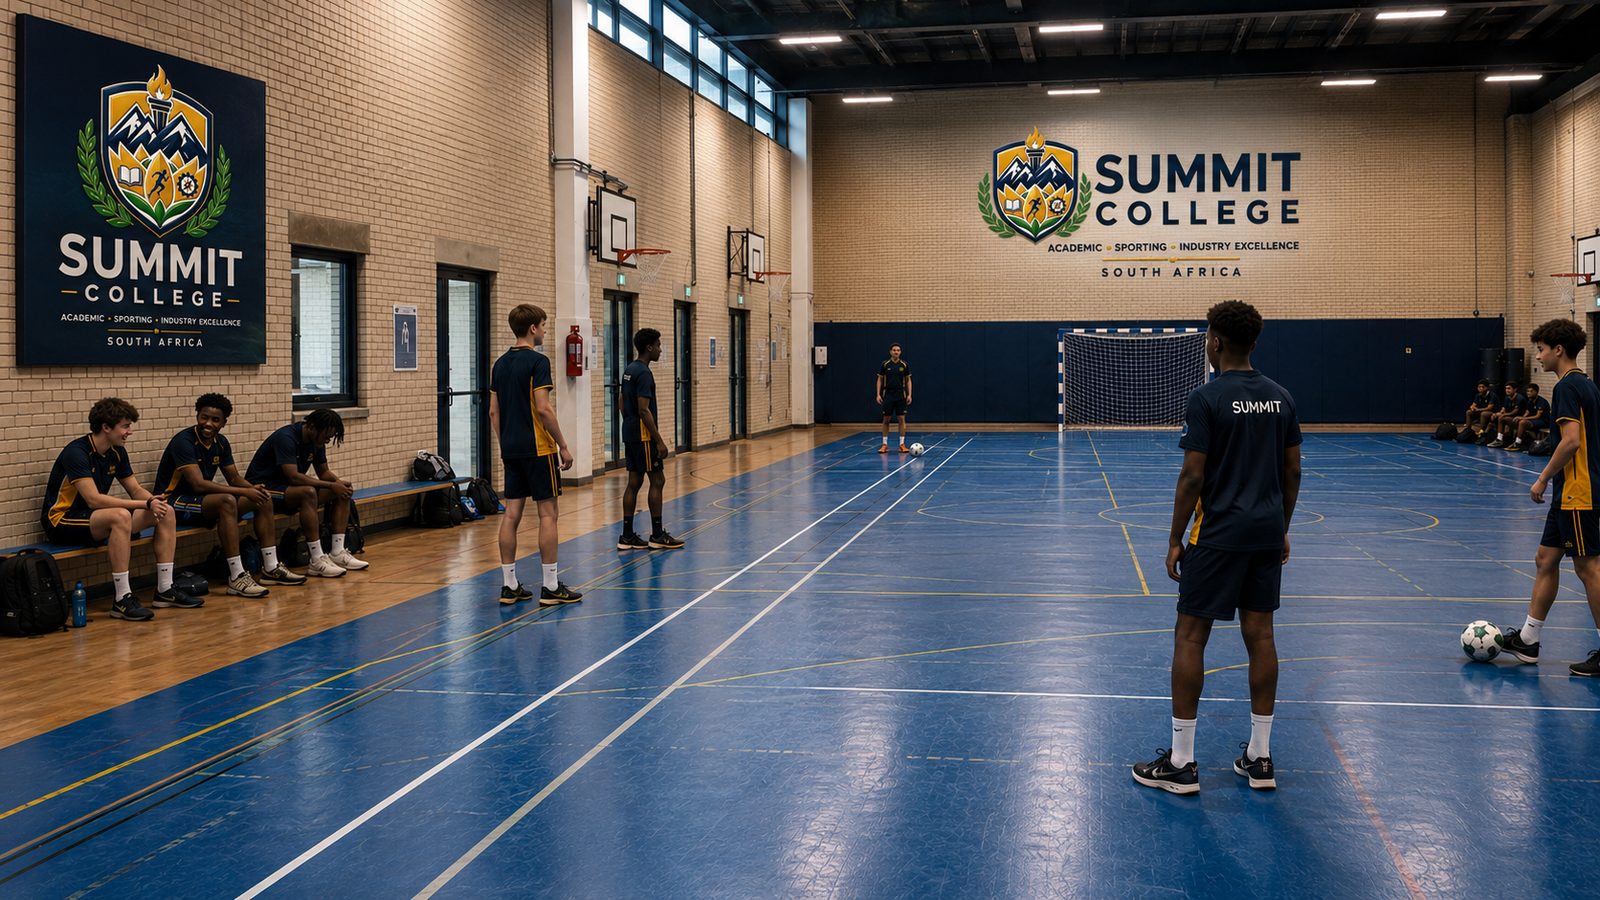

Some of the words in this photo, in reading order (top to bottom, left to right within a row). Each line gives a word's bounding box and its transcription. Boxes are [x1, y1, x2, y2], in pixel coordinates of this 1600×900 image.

[1094, 152, 1301, 194] SUMMIT
[1095, 199, 1299, 226] COLLEGE
[1047, 243, 1102, 253] ACADEMIC
[1114, 242, 1167, 252] SPORTING
[1179, 242, 1231, 251] INDUSTRY
[1234, 241, 1300, 251] EXCELLENCE
[58, 232, 243, 287] SUMMIT
[1101, 267, 1161, 277] SOUTH
[1173, 267, 1241, 277] AFRICA
[84, 283, 222, 308] COLLEGE
[60, 313, 105, 322] ACADEMIC
[113, 315, 153, 324] SPORTING
[160, 317, 197, 326] INDUSTRY
[198, 318, 241, 327] EXCELLENCE
[107, 336, 151, 347] SOUTH
[158, 337, 203, 347] AFRICA
[1232, 400, 1281, 414] SUMMIT
